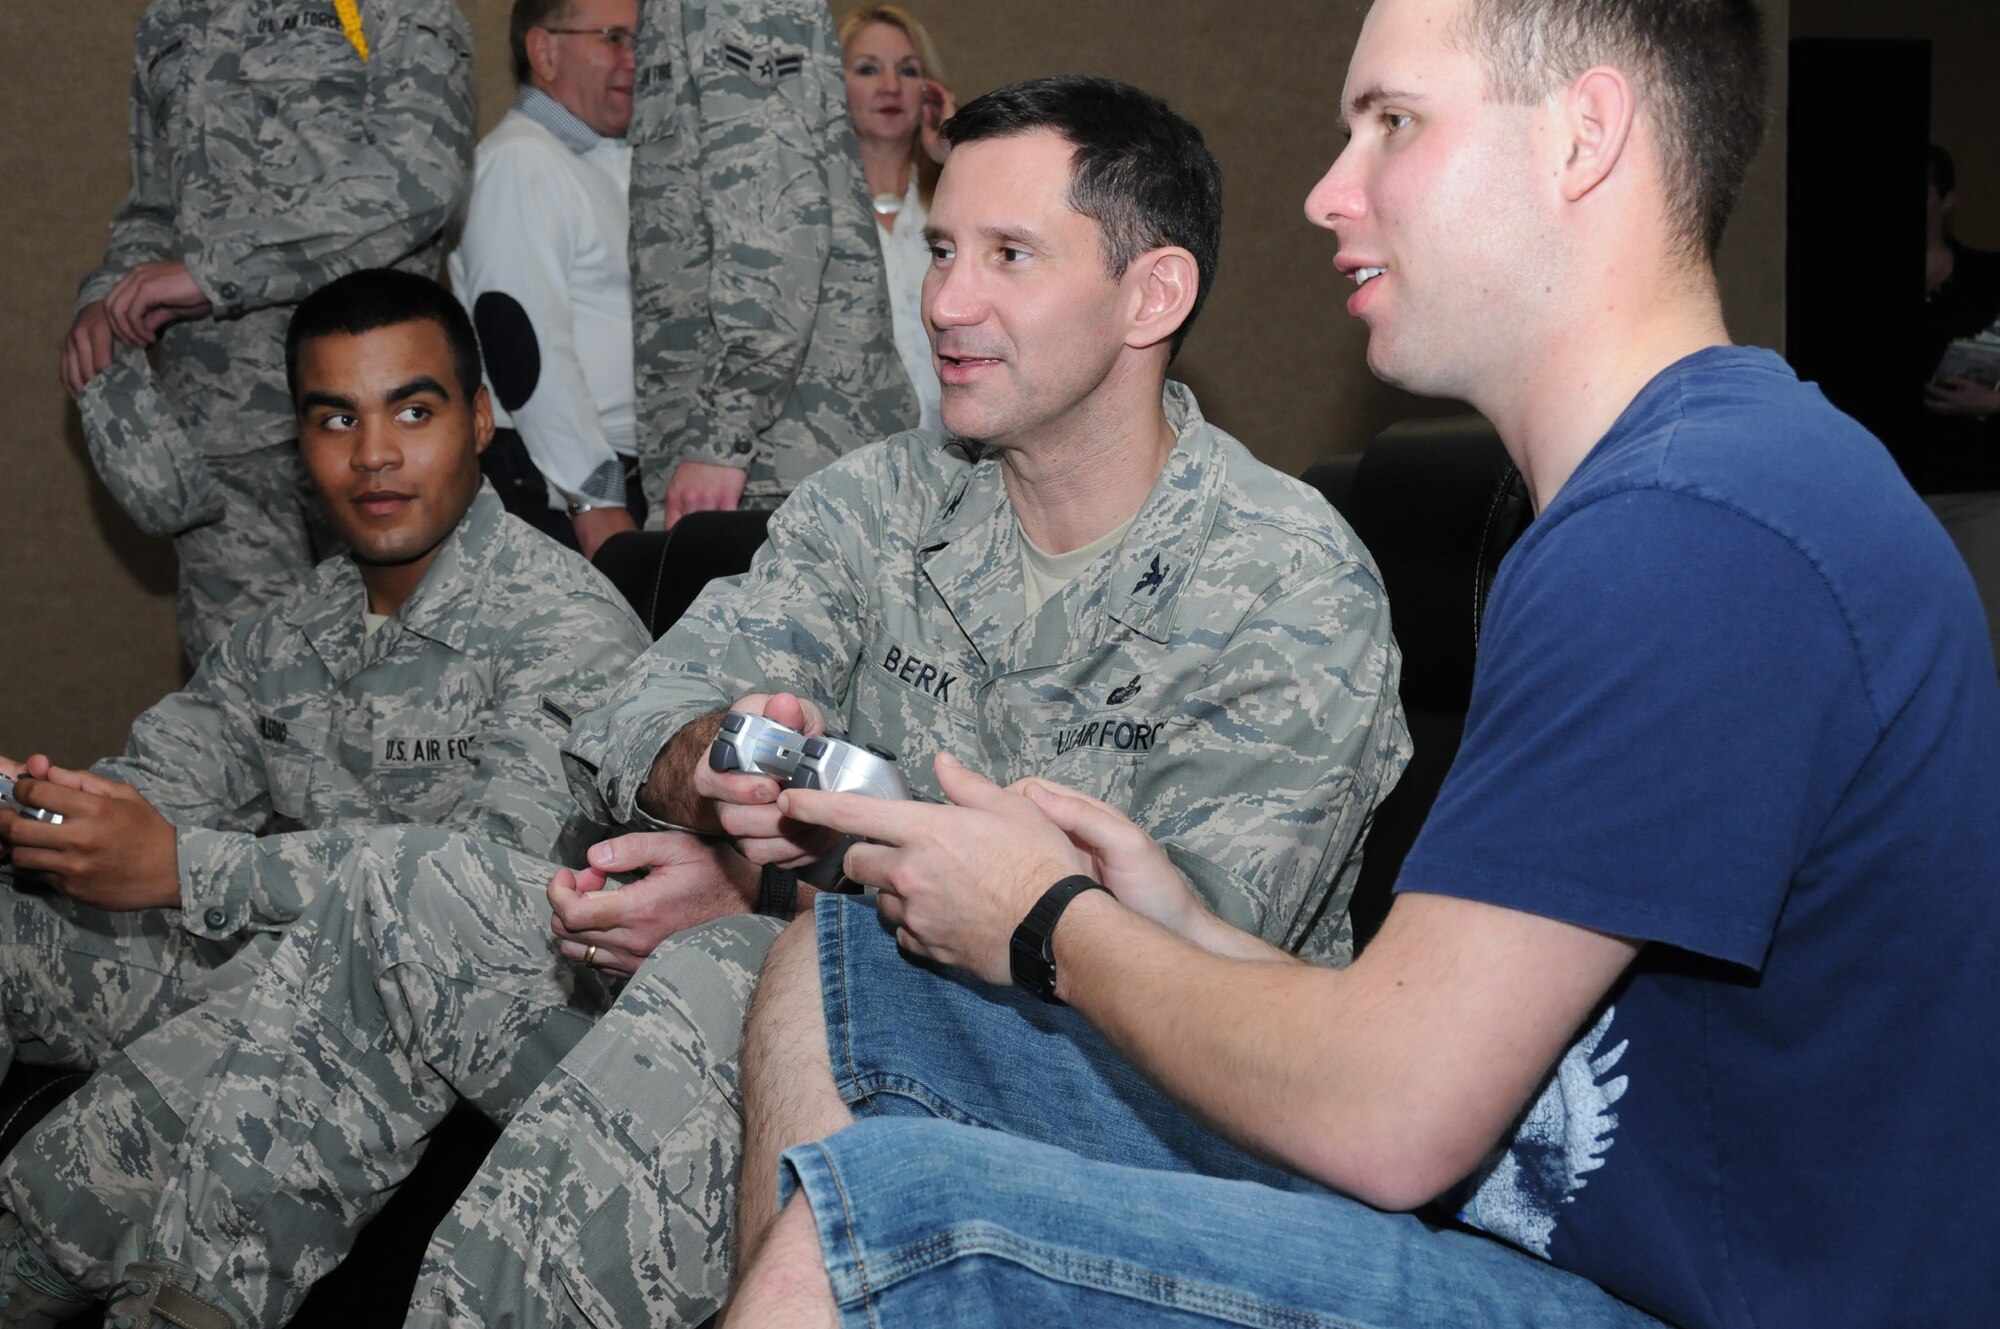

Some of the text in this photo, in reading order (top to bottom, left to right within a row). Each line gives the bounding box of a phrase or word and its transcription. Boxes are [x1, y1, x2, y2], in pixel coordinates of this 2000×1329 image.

[883, 645, 957, 702] BERK
[386, 738, 471, 761] U.S. AIR FO
[1072, 722, 1099, 748] AIR
[1099, 720, 1165, 750] FORC
